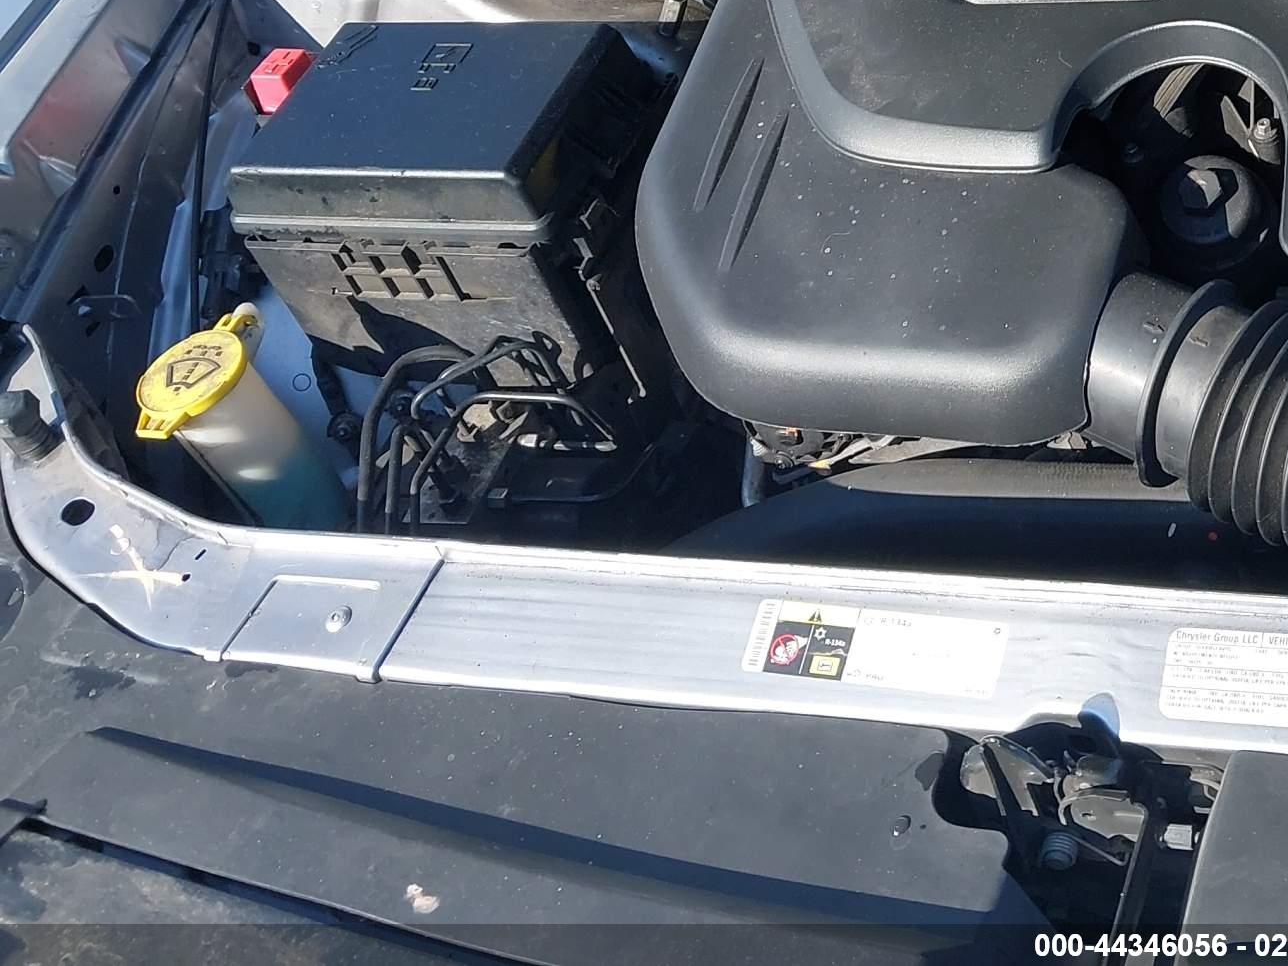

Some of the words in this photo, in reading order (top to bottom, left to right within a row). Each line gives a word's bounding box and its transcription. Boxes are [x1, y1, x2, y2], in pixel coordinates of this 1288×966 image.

[1176, 630, 1211, 643] Chrysler
[1213, 632, 1240, 644] Group
[1242, 633, 1259, 644] LLC
